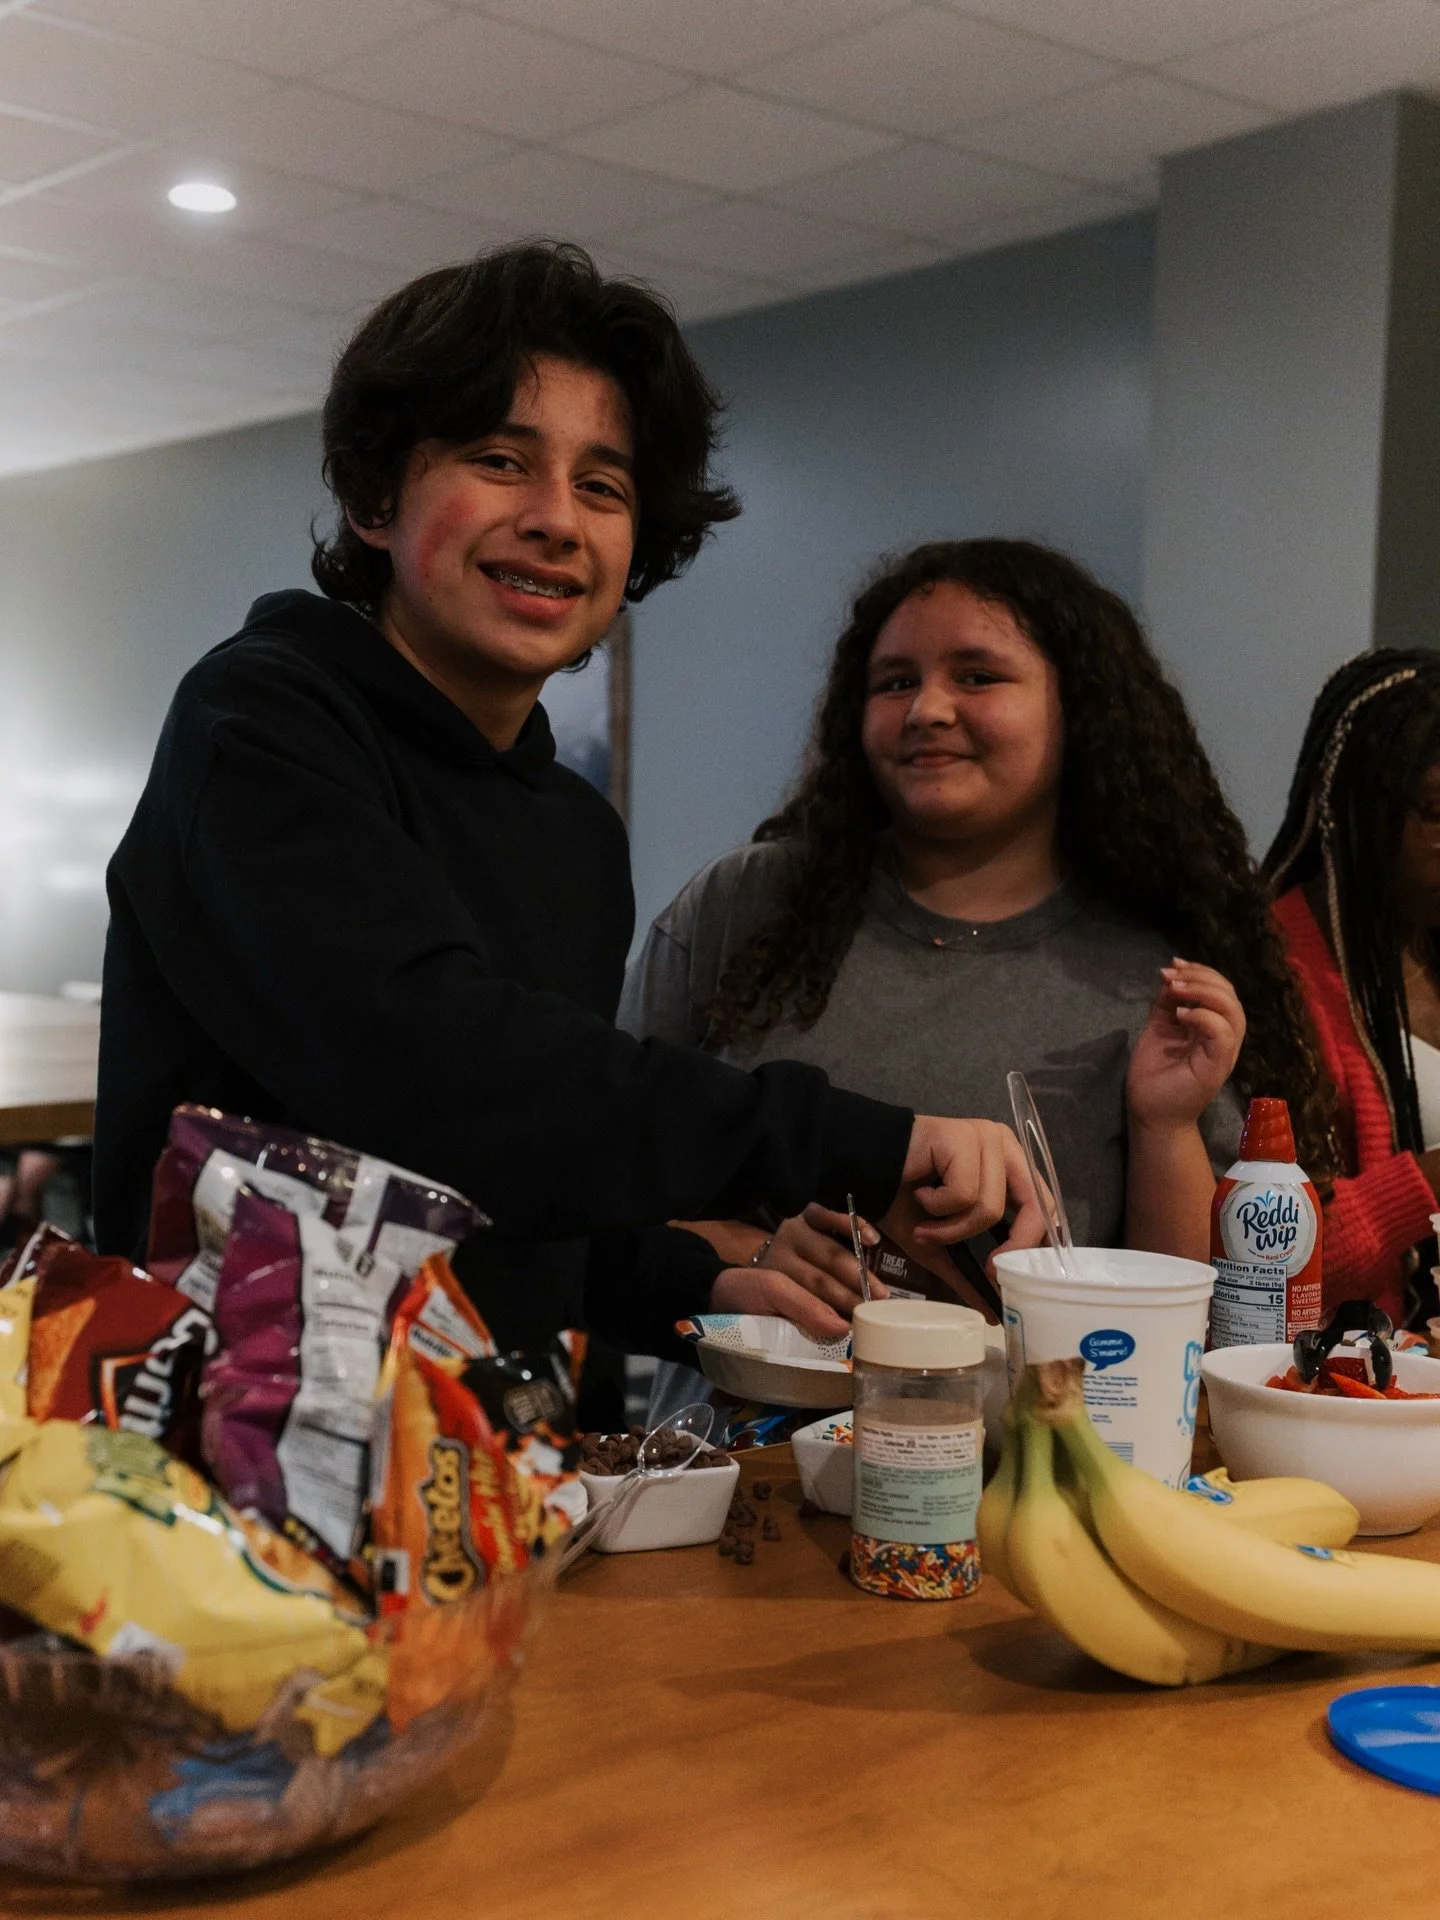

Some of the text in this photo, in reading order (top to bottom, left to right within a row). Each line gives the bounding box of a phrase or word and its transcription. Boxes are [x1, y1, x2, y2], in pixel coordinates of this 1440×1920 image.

[1236, 1195, 1299, 1239] Reddi
[882, 1252, 906, 1269] TREAT
[1253, 1266, 1284, 1275] Facts
[1268, 1294, 1284, 1304] 15
